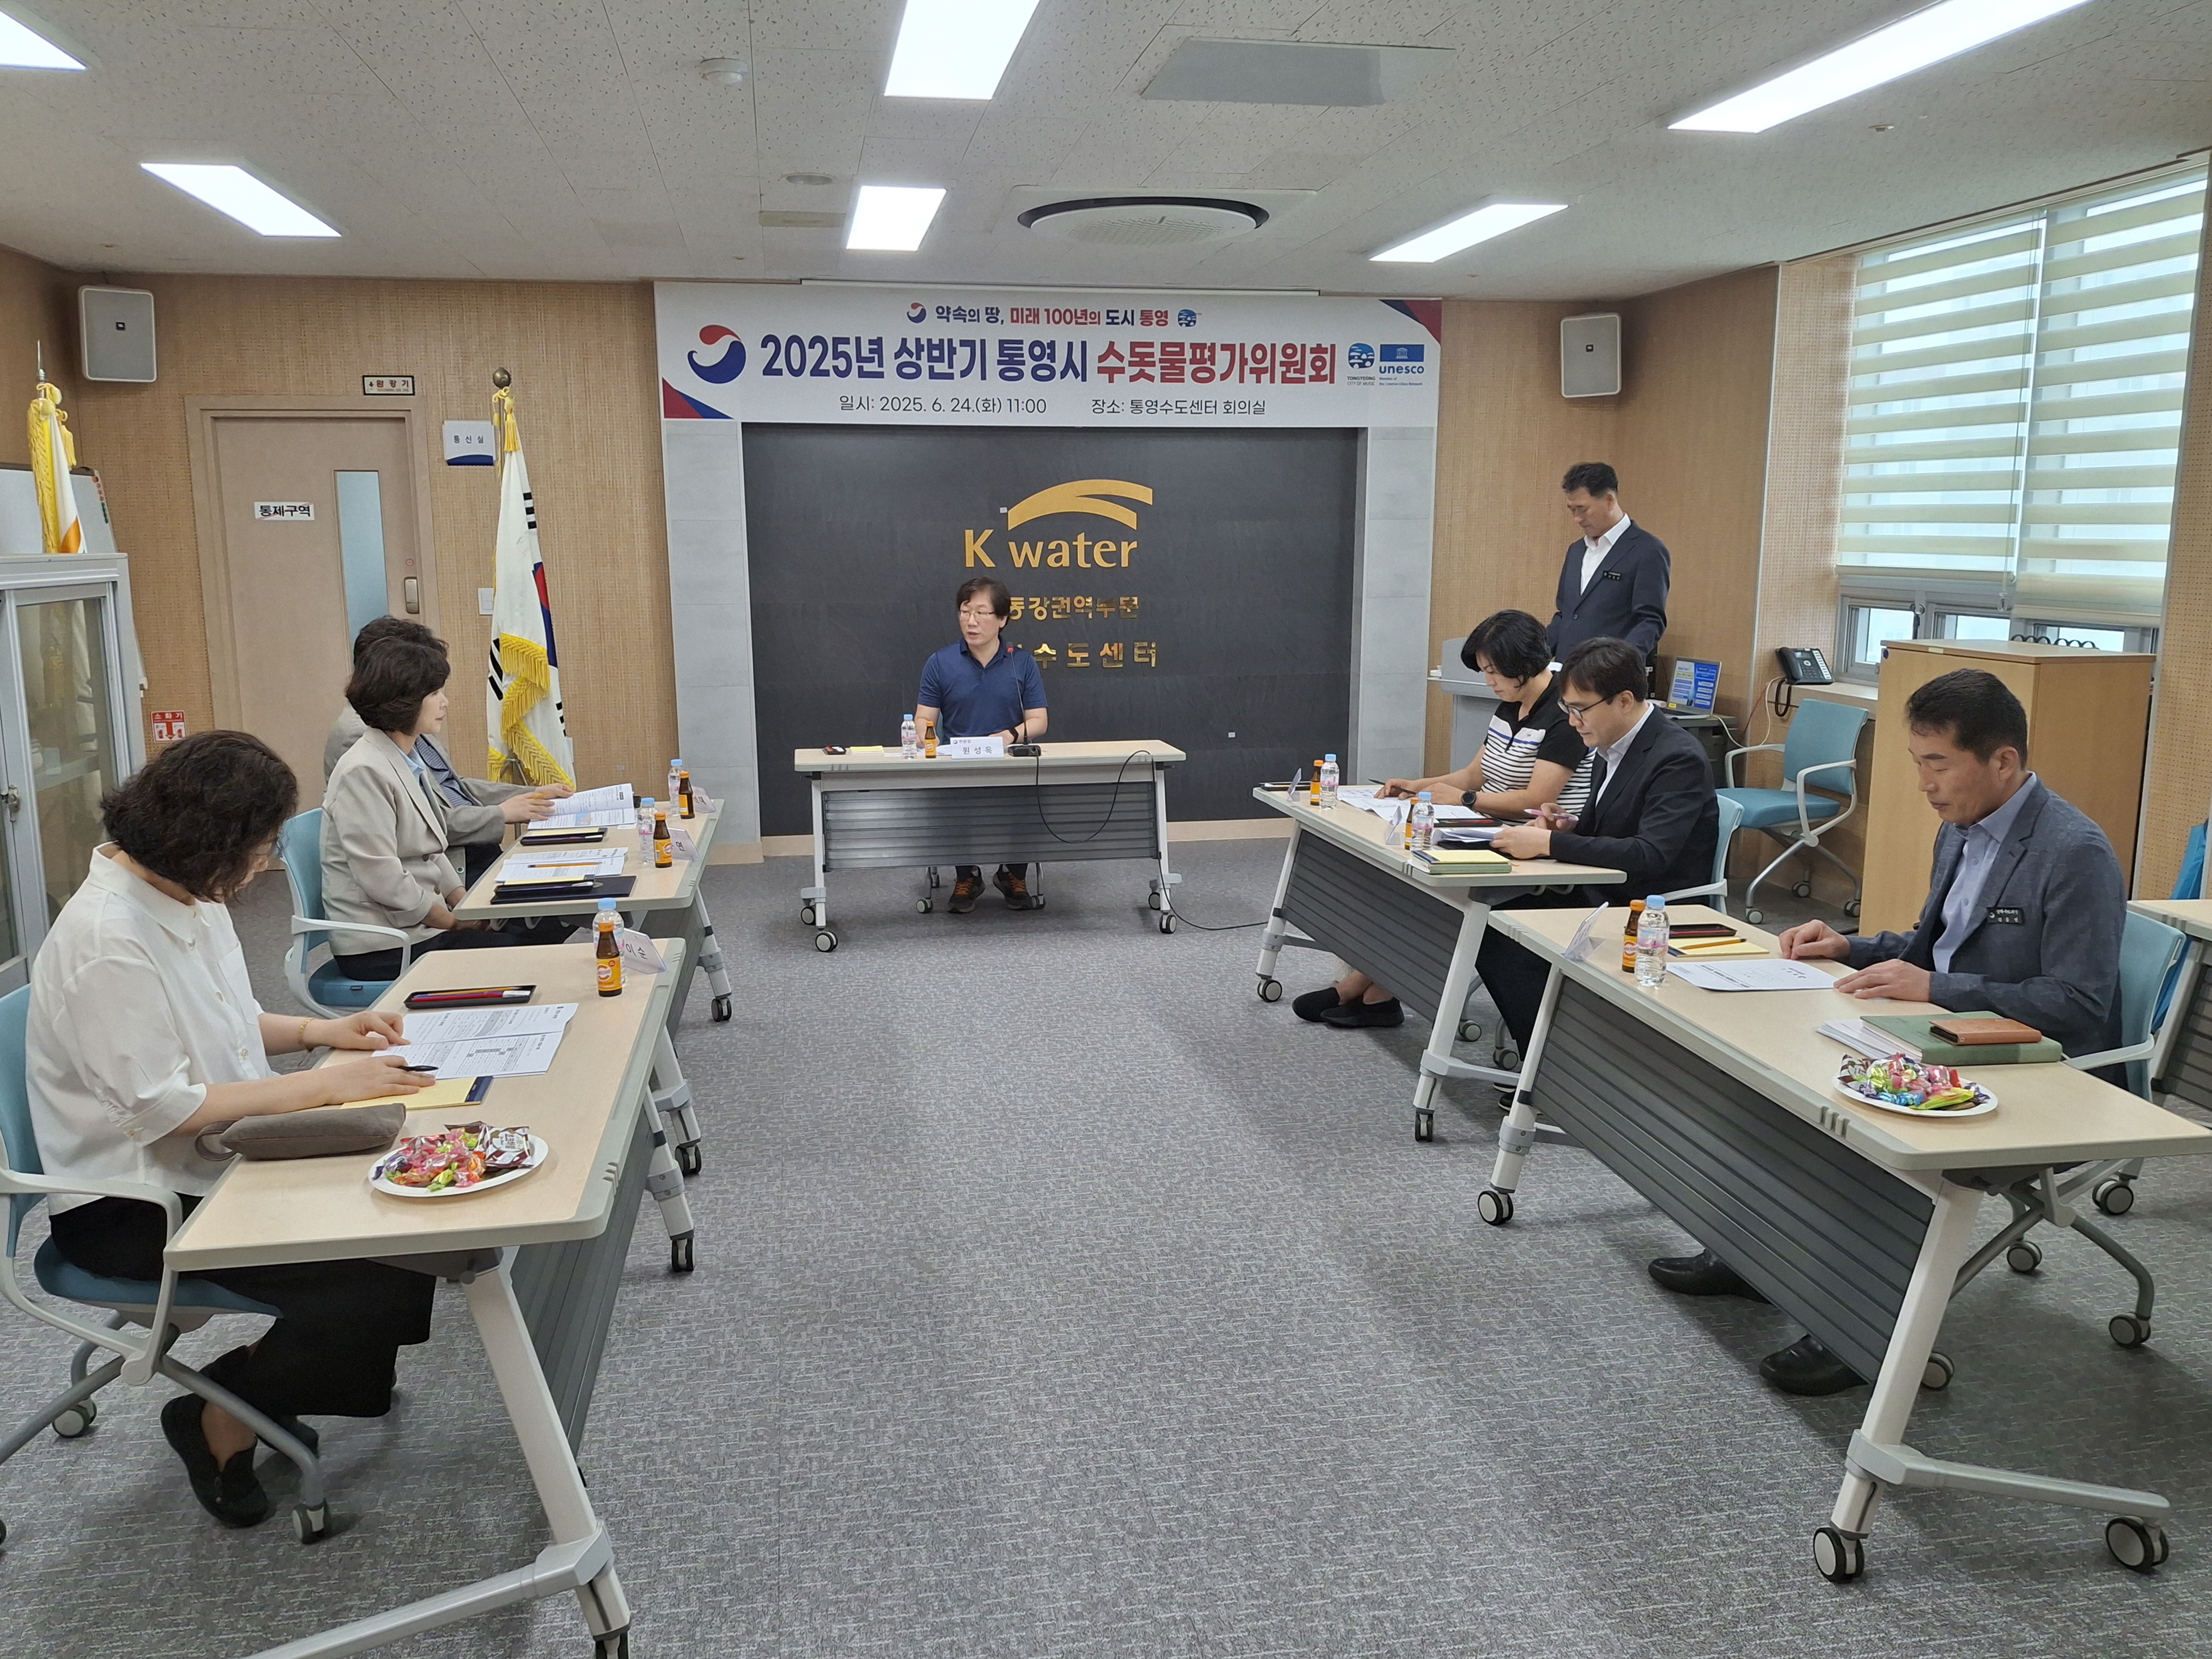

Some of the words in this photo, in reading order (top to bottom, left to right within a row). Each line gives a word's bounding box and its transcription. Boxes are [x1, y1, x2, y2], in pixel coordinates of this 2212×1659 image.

[935, 305, 980, 324] 약속의
[985, 306, 1005, 325] 땅,
[1010, 307, 1040, 325] 미래
[1044, 307, 1101, 326] 100년의
[1105, 309, 1135, 327] 도시
[1139, 309, 1169, 327] 통영
[760, 334, 885, 380] 2025년
[893, 337, 987, 381] 상반기
[996, 339, 1088, 383] 통영시
[1097, 340, 1336, 384] 수돗물평가위원회
[1379, 365, 1424, 374] unesco
[839, 395, 874, 411] 일시:
[879, 396, 927, 412] 2025.
[932, 397, 945, 412] 6.
[950, 397, 1002, 414] 24.(화)
[1006, 398, 1046, 414] 11:00
[1091, 399, 1125, 415] 장소:
[1130, 399, 1218, 415] 통영수도센터
[1223, 400, 1266, 415] 회의실
[259, 505, 310, 517] 통제구역
[964, 529, 996, 568] K
[1008, 532, 1138, 568] water
[1017, 641, 1157, 669] 수도센터
